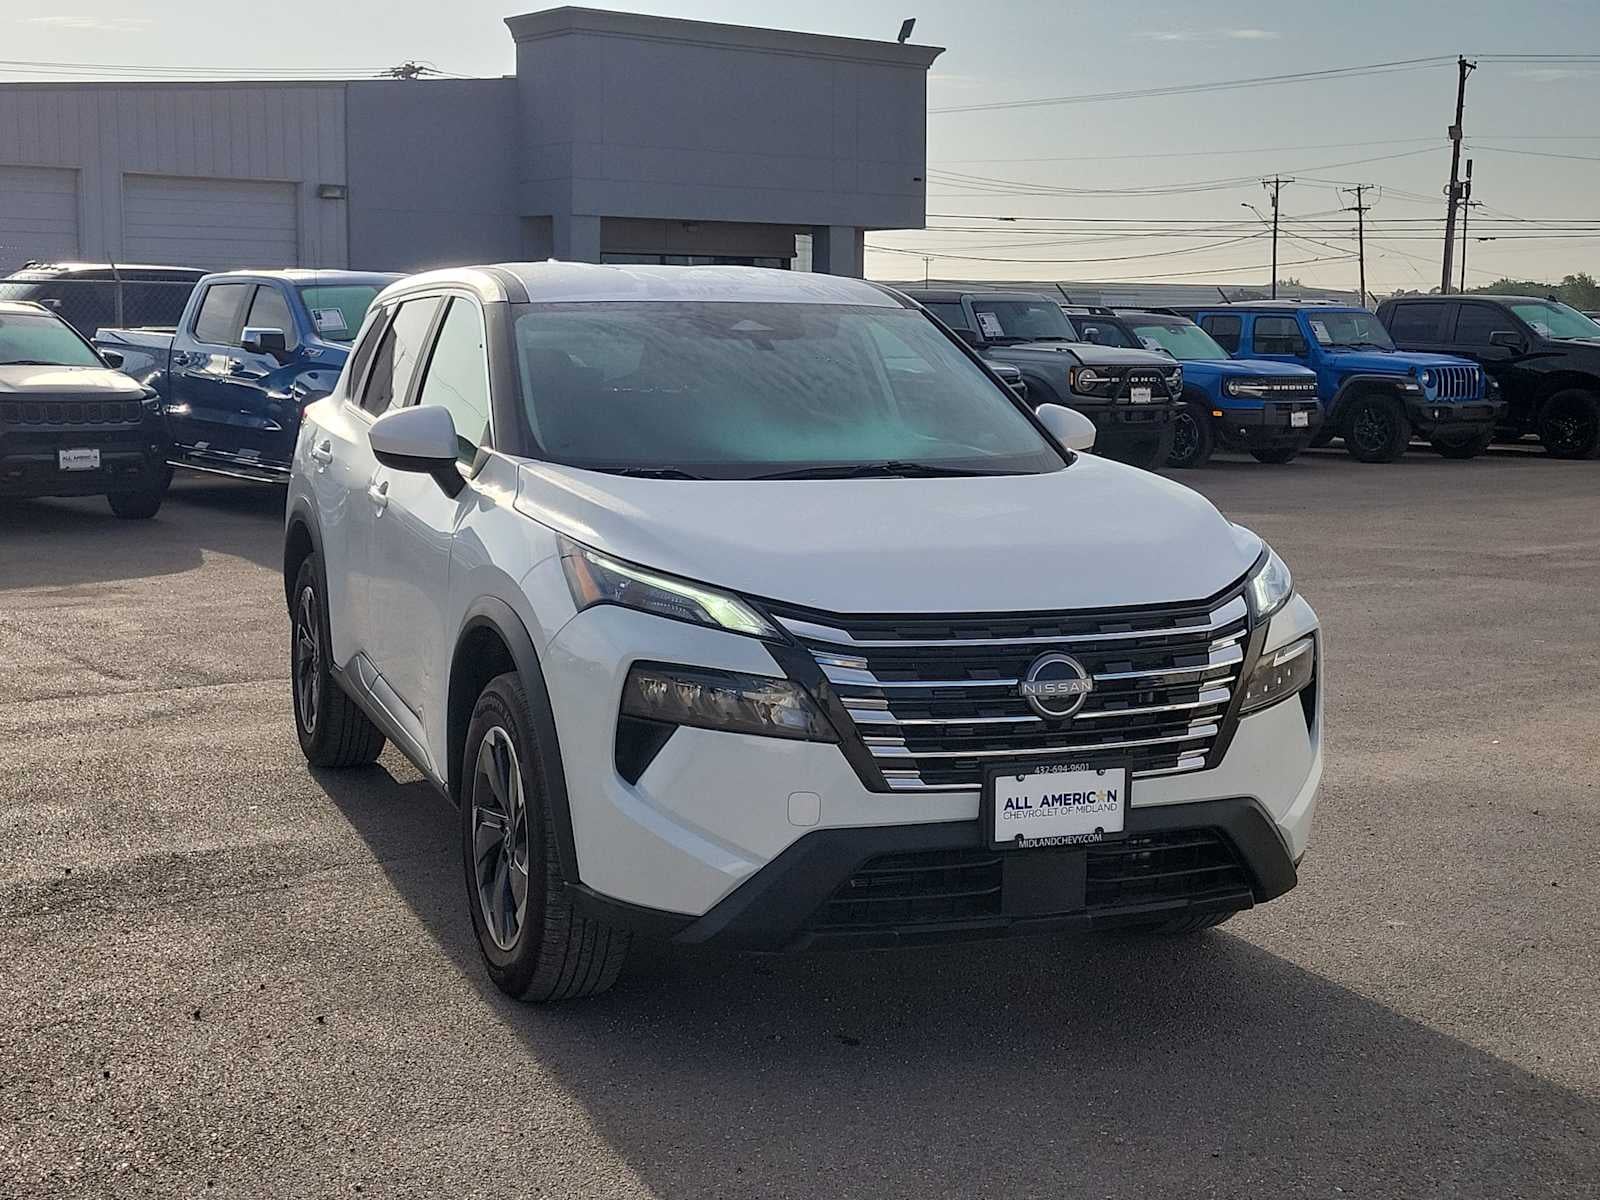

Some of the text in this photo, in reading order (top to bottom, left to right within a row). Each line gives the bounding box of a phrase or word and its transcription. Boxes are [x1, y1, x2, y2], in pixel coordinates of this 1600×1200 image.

[1024, 681, 1091, 693] NISSAN
[1034, 762, 1089, 775] 432-694-9601
[1004, 796, 1032, 811] ALL
[1003, 803, 1118, 820] CHEVROLET OF MIDLAND
[1018, 833, 1102, 848] MIDLANDCHEVY.COM
